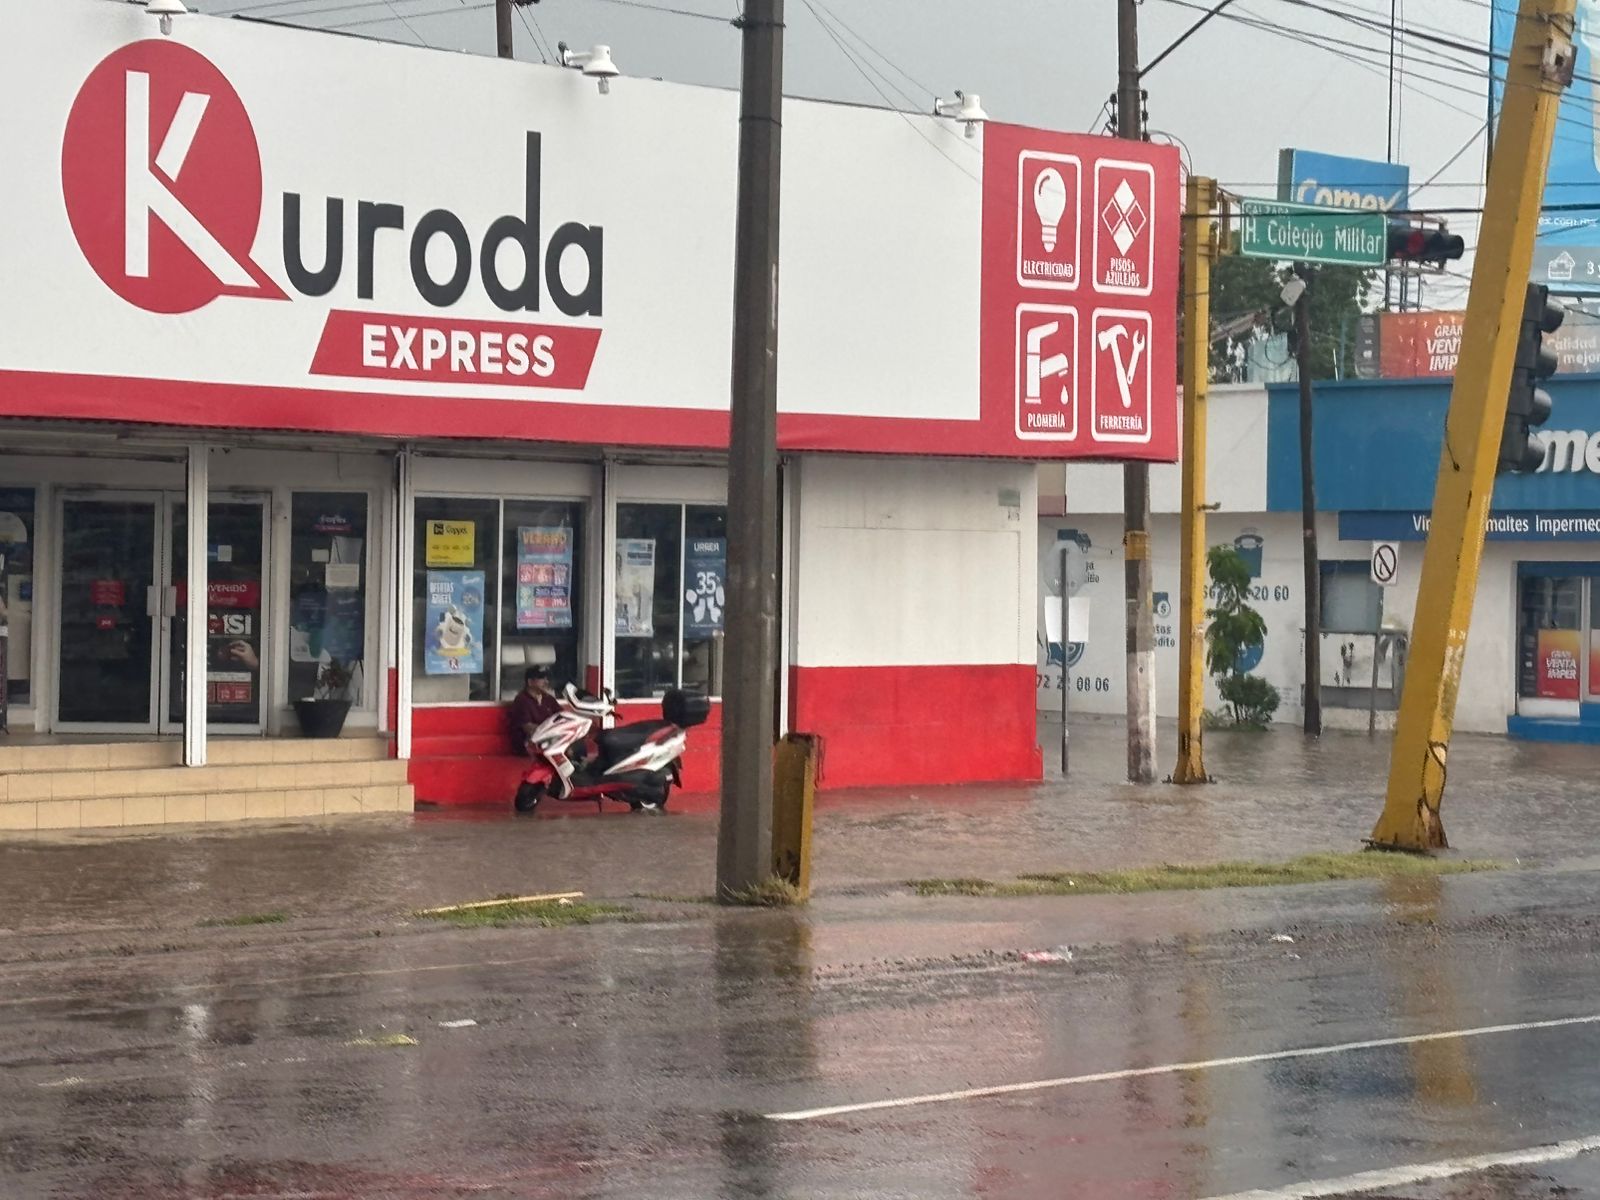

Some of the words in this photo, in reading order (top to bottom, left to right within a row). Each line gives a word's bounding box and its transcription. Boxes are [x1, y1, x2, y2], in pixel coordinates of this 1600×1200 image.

[124, 70, 603, 317] Kuroda
[1245, 216, 1260, 244] H.
[1267, 219, 1324, 257] Colegio
[1335, 225, 1382, 255] Militar
[1023, 259, 1074, 278] ELECTRICIDAD
[1110, 257, 1131, 271] PISOS
[1105, 271, 1140, 287] AZULEJOS
[362, 323, 556, 379] EXPRESS
[1429, 354, 1458, 372] IMP
[1027, 411, 1066, 428] PLOMERÍA
[1100, 413, 1143, 430] FERRETERÍA
[1485, 514, 1529, 533] maltes
[696, 571, 716, 595] 35
[1274, 585, 1289, 601] 60
[1546, 657, 1577, 669] VENTA
[1095, 678, 1110, 692] 06
